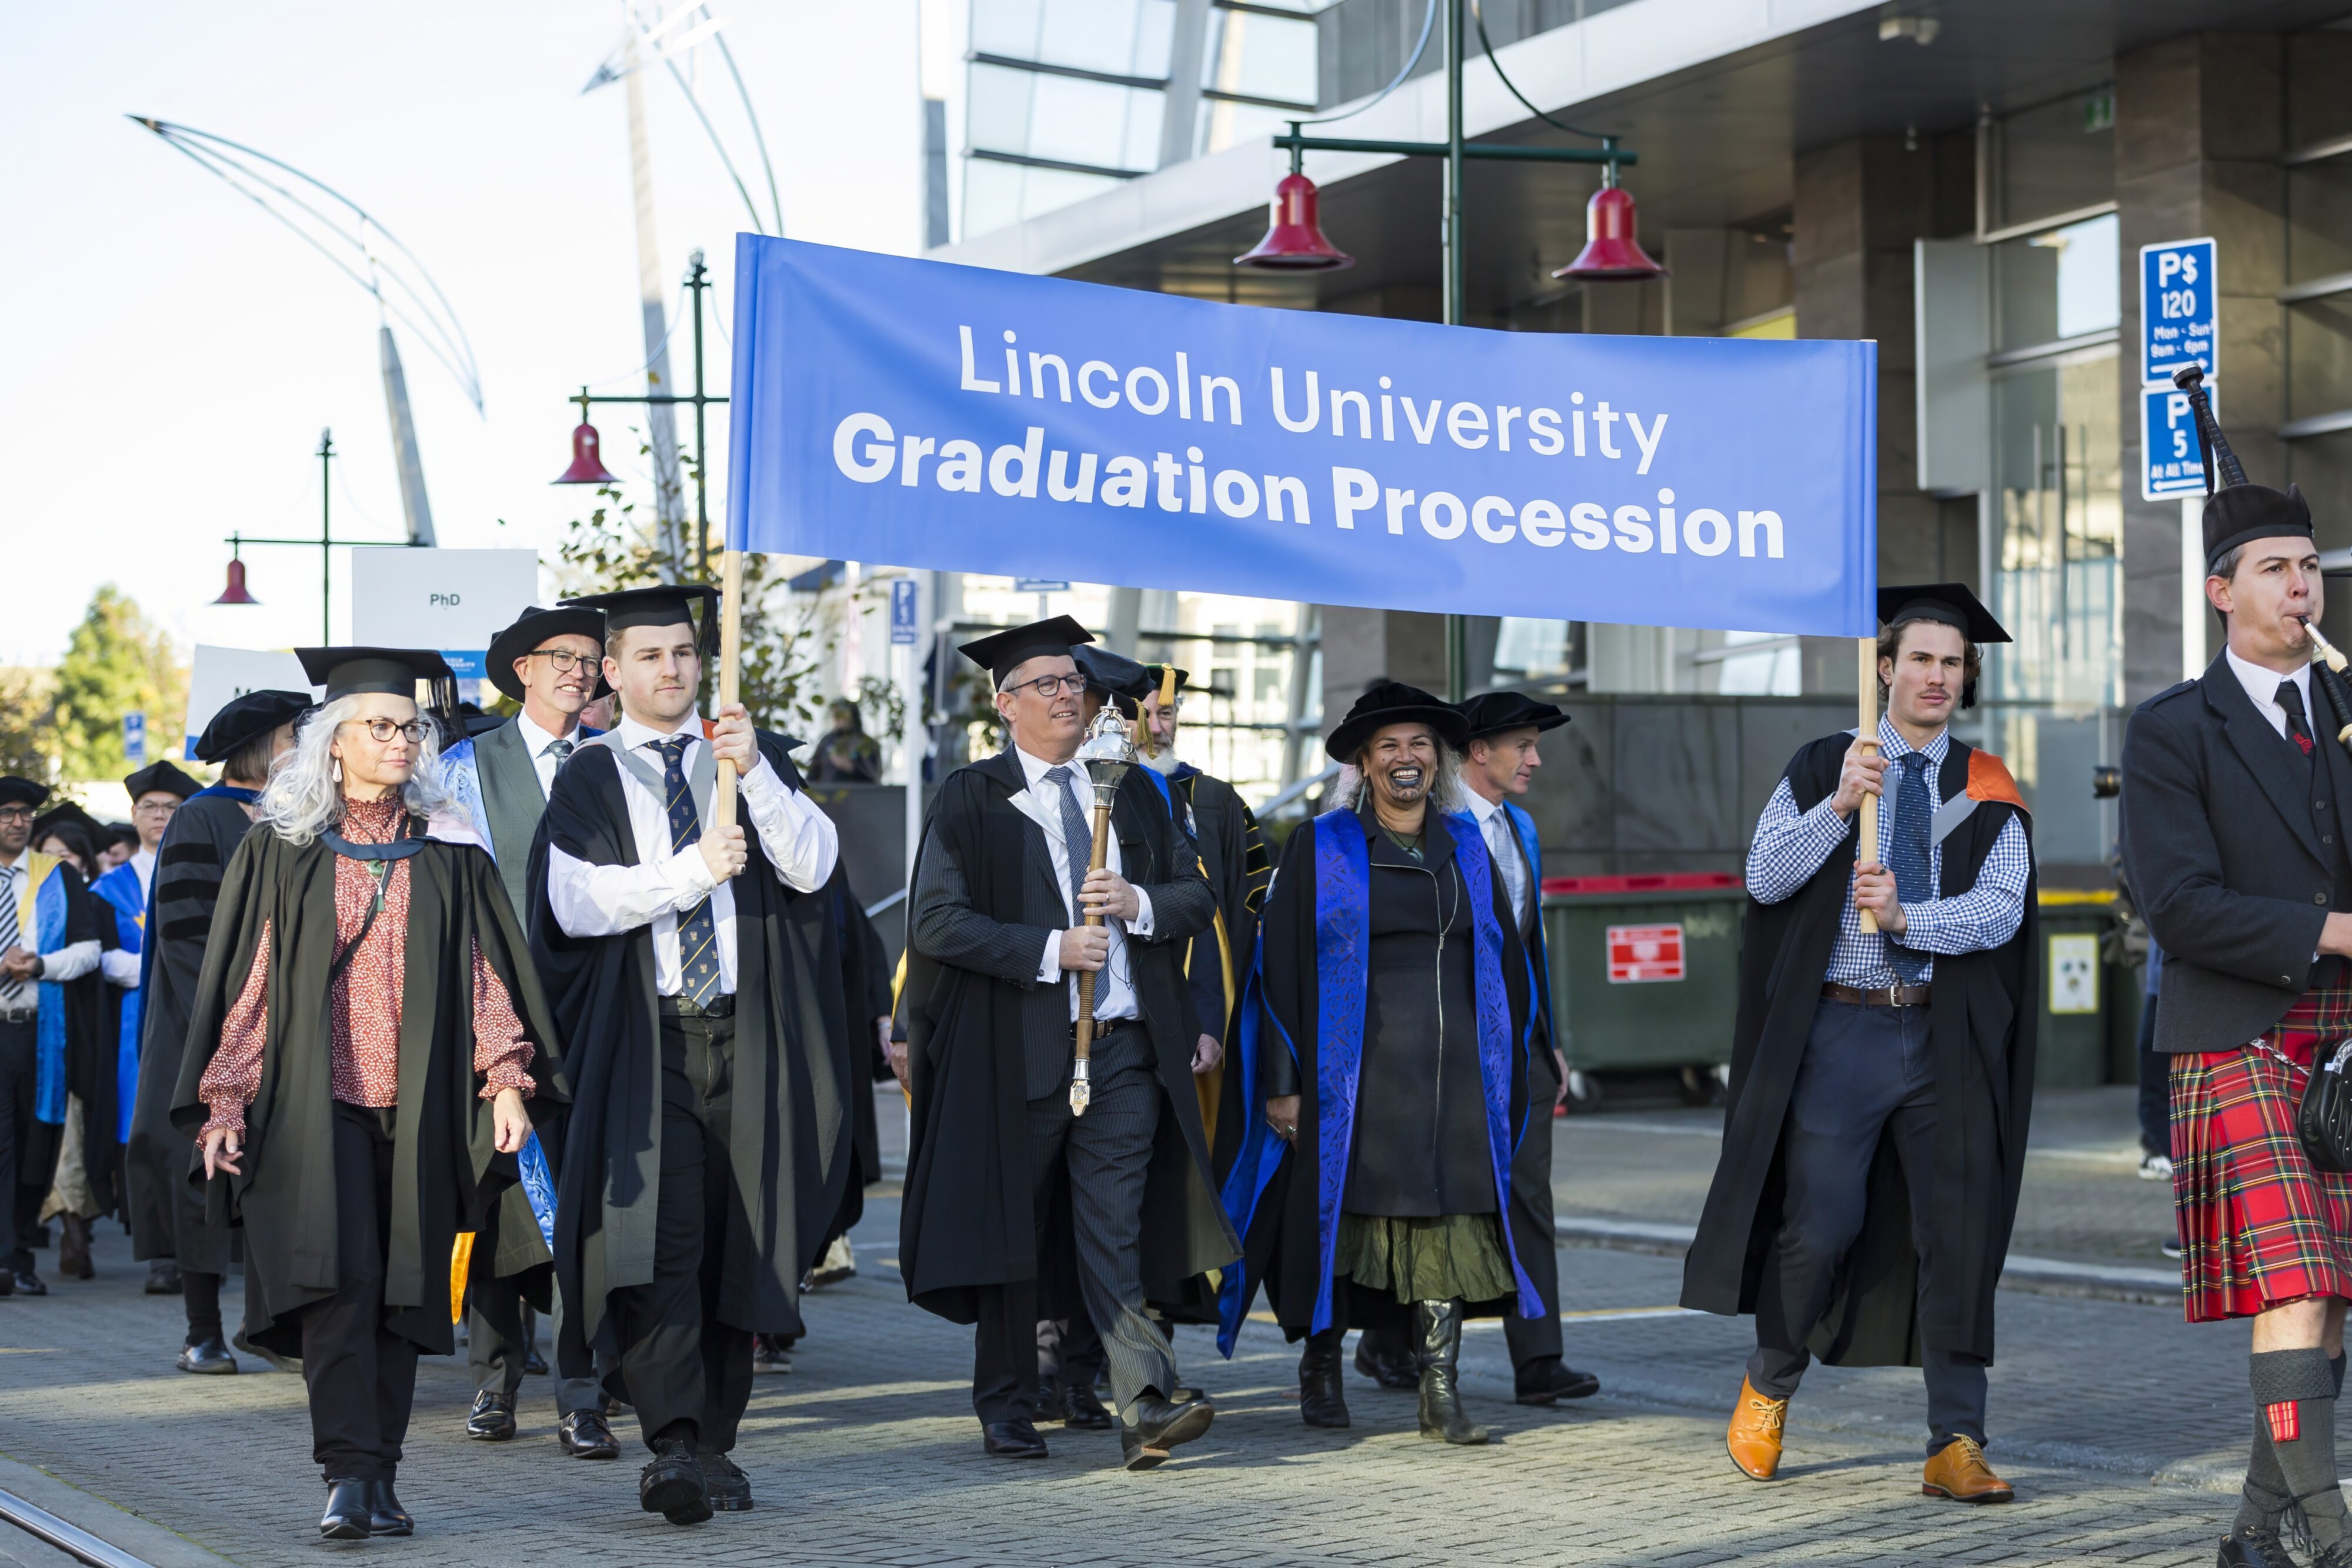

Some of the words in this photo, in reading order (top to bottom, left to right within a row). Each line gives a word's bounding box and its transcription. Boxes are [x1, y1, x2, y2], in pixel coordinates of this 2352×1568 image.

[2161, 289, 2197, 319] 120
[2153, 326, 2180, 341] Mon
[2151, 343, 2176, 358] 9am
[2184, 339, 2210, 356] 6pm
[959, 325, 1243, 426] Lincoln
[1270, 366, 1669, 476] University
[2167, 392, 2190, 429] P
[2173, 429, 2188, 458] 5
[832, 412, 1311, 525] Graduation
[1331, 465, 1784, 559] Procession
[2150, 463, 2164, 480] At
[2166, 462, 2181, 478] All
[430, 594, 461, 606] PhD
